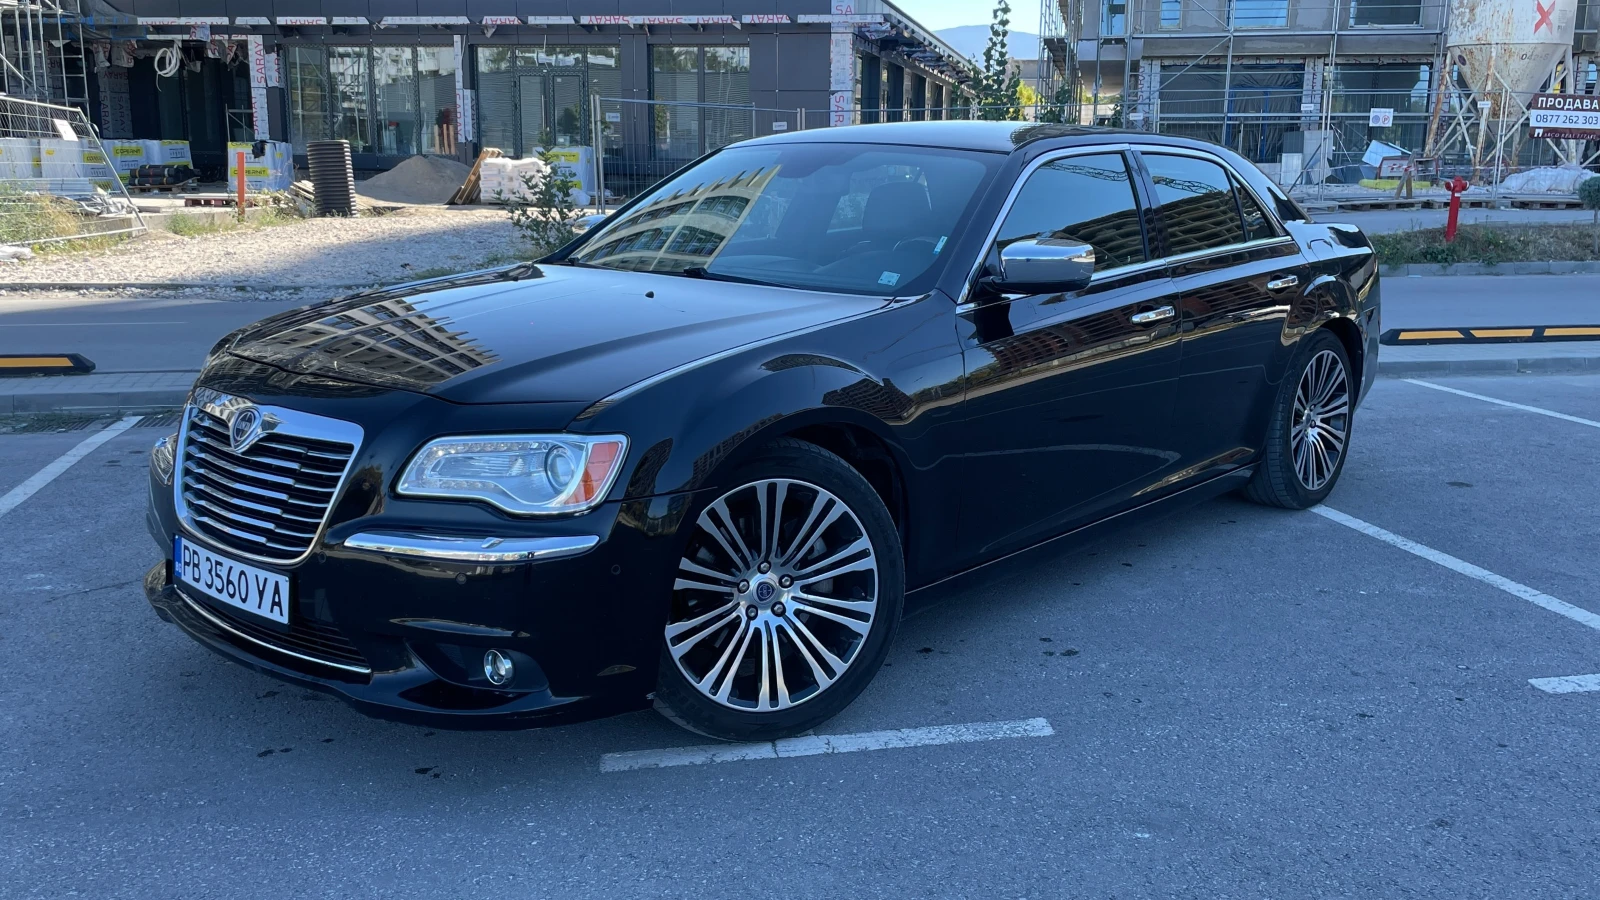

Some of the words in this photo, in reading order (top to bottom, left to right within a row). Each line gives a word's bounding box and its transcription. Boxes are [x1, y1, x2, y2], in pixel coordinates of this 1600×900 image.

[587, 16, 630, 24] SARAY
[254, 40, 265, 83] SARAY
[101, 95, 111, 132] SARAY
[118, 95, 126, 133] SARAY
[1535, 114, 1560, 123] 0877
[1562, 115, 1580, 124] 262
[1581, 116, 1599, 125] 303
[1538, 97, 1599, 110] ПРОДАВА
[183, 544, 201, 583] PB
[205, 556, 249, 603] 3560
[255, 574, 284, 617] YA
